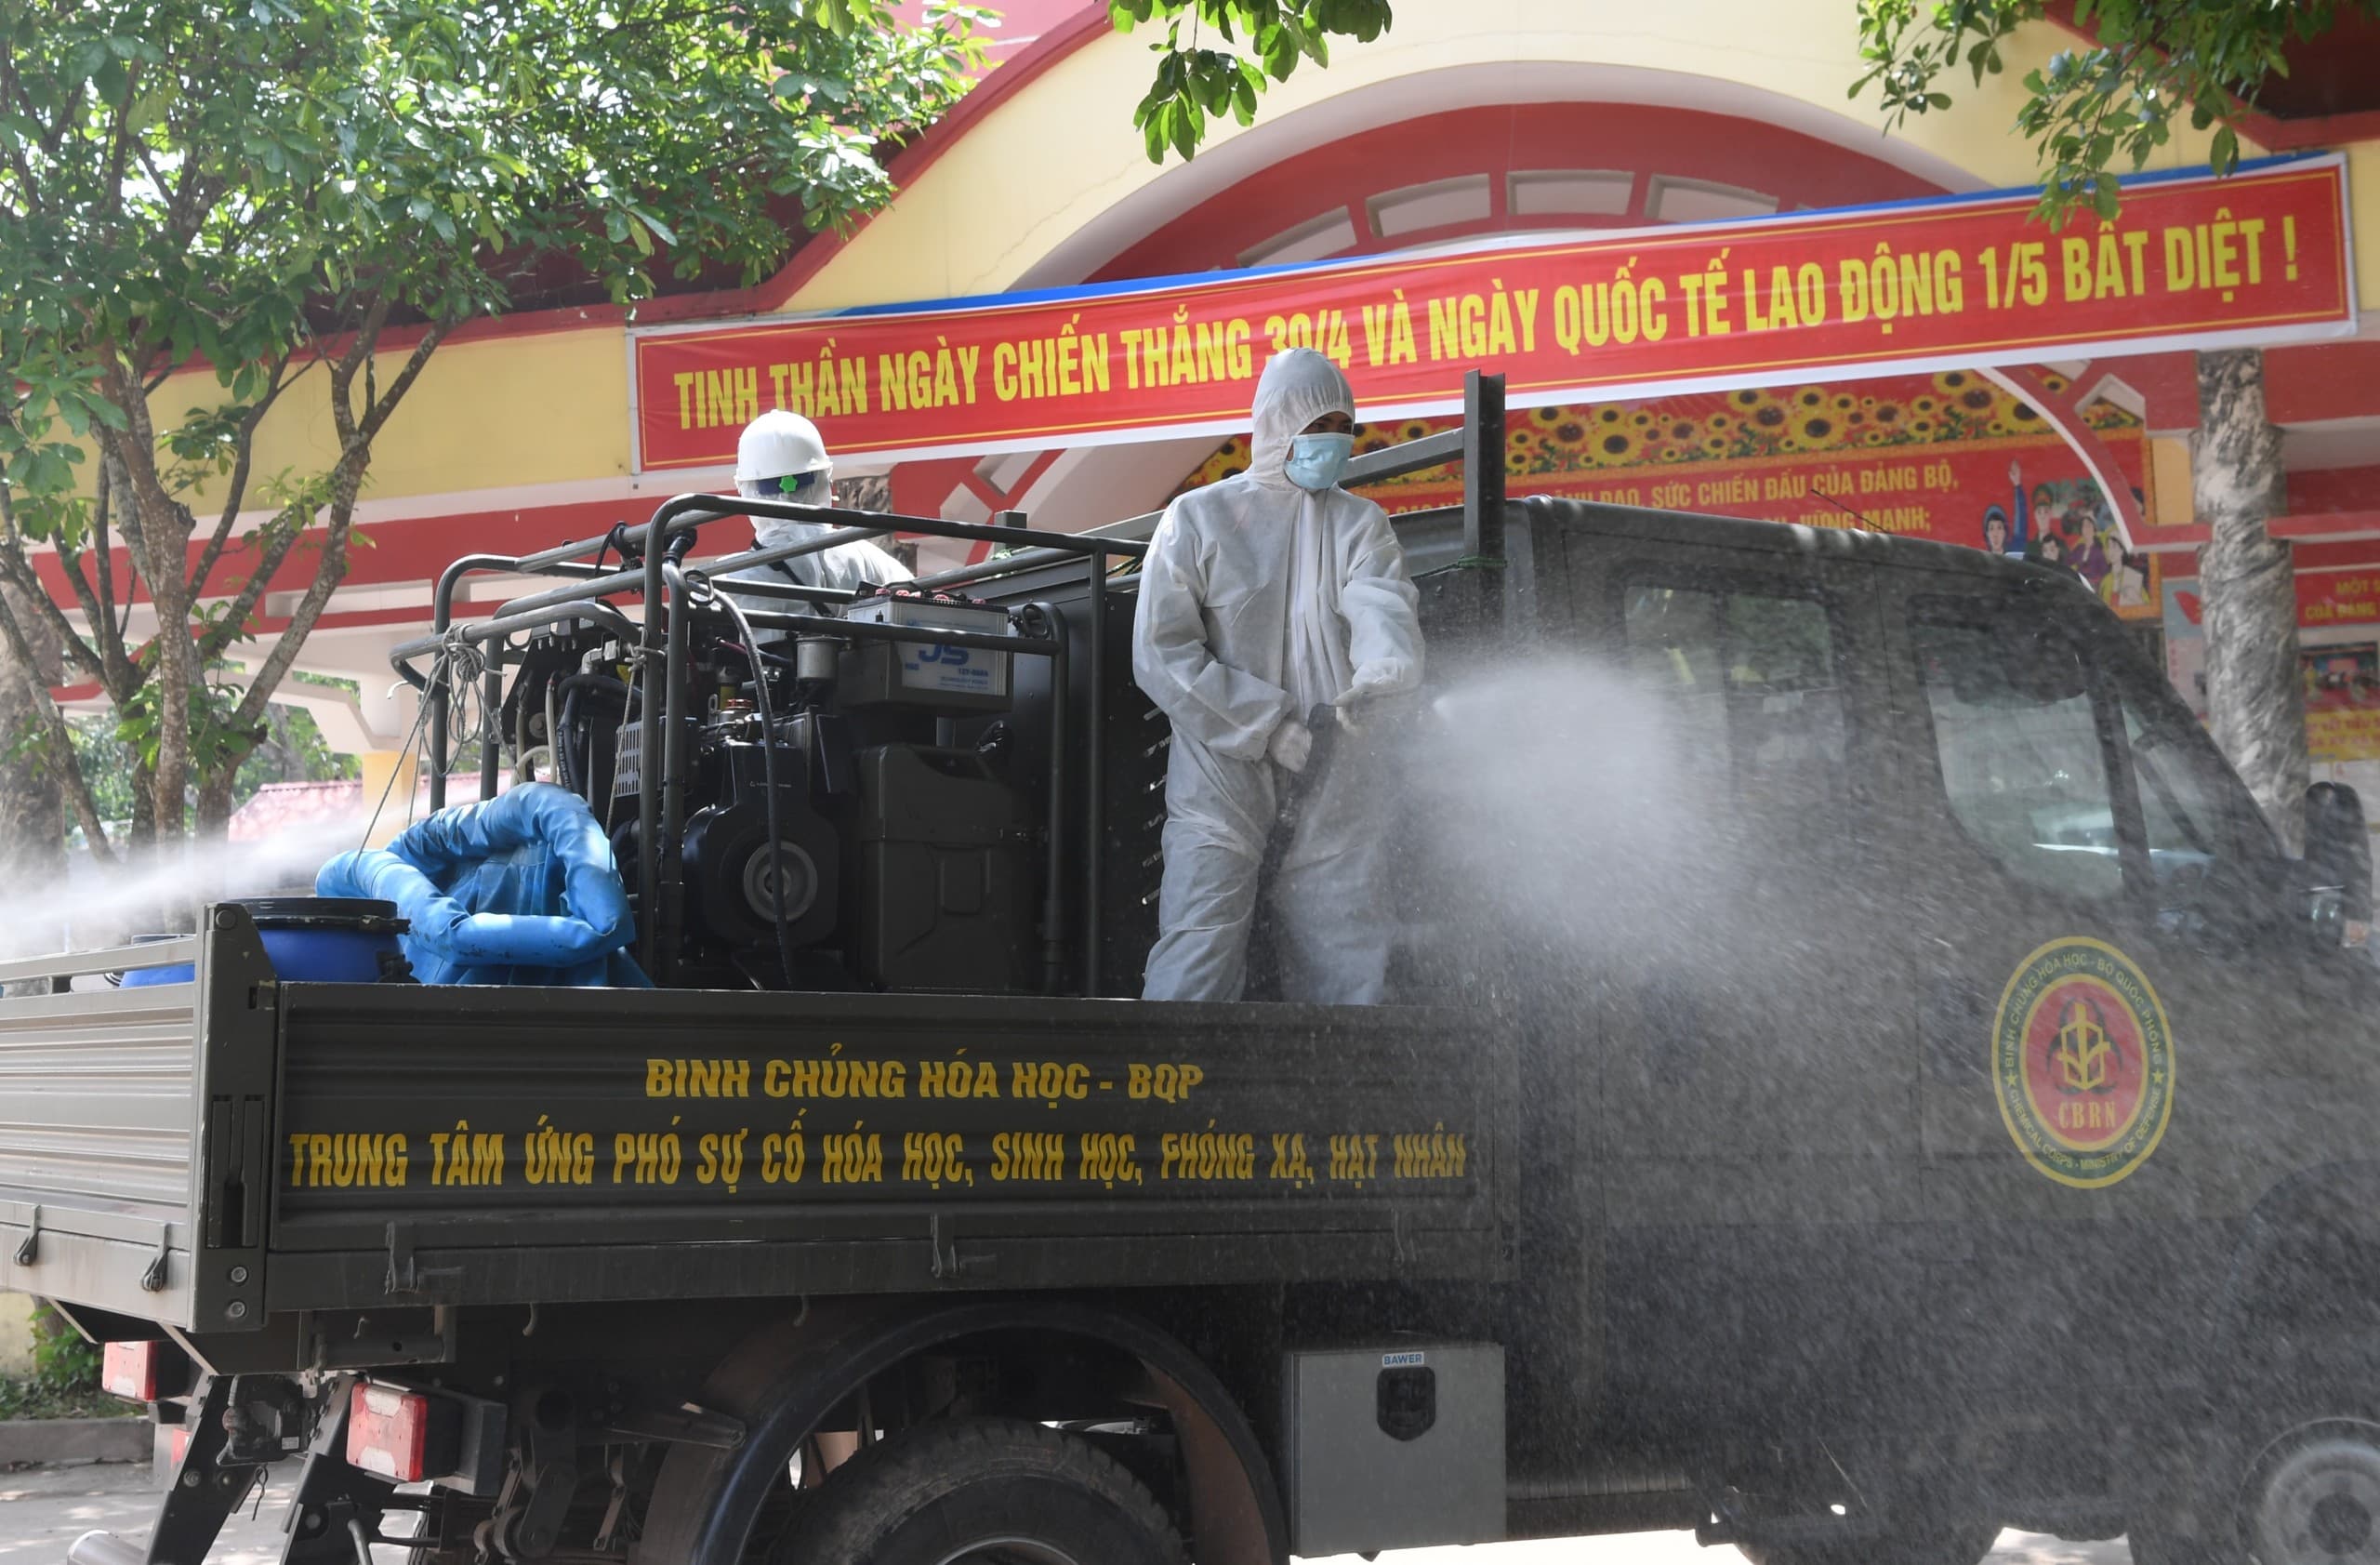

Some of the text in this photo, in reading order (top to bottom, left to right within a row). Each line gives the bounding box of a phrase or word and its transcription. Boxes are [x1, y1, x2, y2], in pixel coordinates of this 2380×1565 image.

[674, 208, 2296, 429] TINH THẦN NGÀY CHIẾN THẮNG 30/4 VÀ NGÀY QUỐC TẾ LAO ĐỘNG 1/5 BẤT DIỆT !
[1652, 477, 1692, 510] SỨC
[1699, 472, 1760, 507] CHIẾN
[1765, 468, 1806, 499] ĐẤU
[1812, 466, 1855, 496] CỦA
[1860, 464, 1918, 493] ĐẢNG
[1924, 459, 1959, 492] BỘ,
[646, 1059, 751, 1097] BINH
[764, 1043, 906, 1098] CHỦNG
[919, 1049, 998, 1098] HÓA
[1012, 1062, 1090, 1108] HỌC
[1129, 1064, 1203, 1103] BQP
[2005, 1029, 2016, 1068] BINH
[2009, 1089, 2043, 1147] CHEMICAL
[2043, 1142, 2074, 1169] CORPS
[2080, 1149, 2123, 1170] MINISTRY
[2122, 1139, 2137, 1154] OF
[2135, 1088, 2162, 1141] DEFENSE
[2057, 1101, 2116, 1130] CBRN
[291, 1108, 1465, 1193] TRUNG TÂM ỨNG PHÓ SỰ CỐ HÓA HỌC, SINH HỌC, PHÓNG XẠ, HẠT NHÂN
[1383, 1354, 1422, 1365] BAWER
